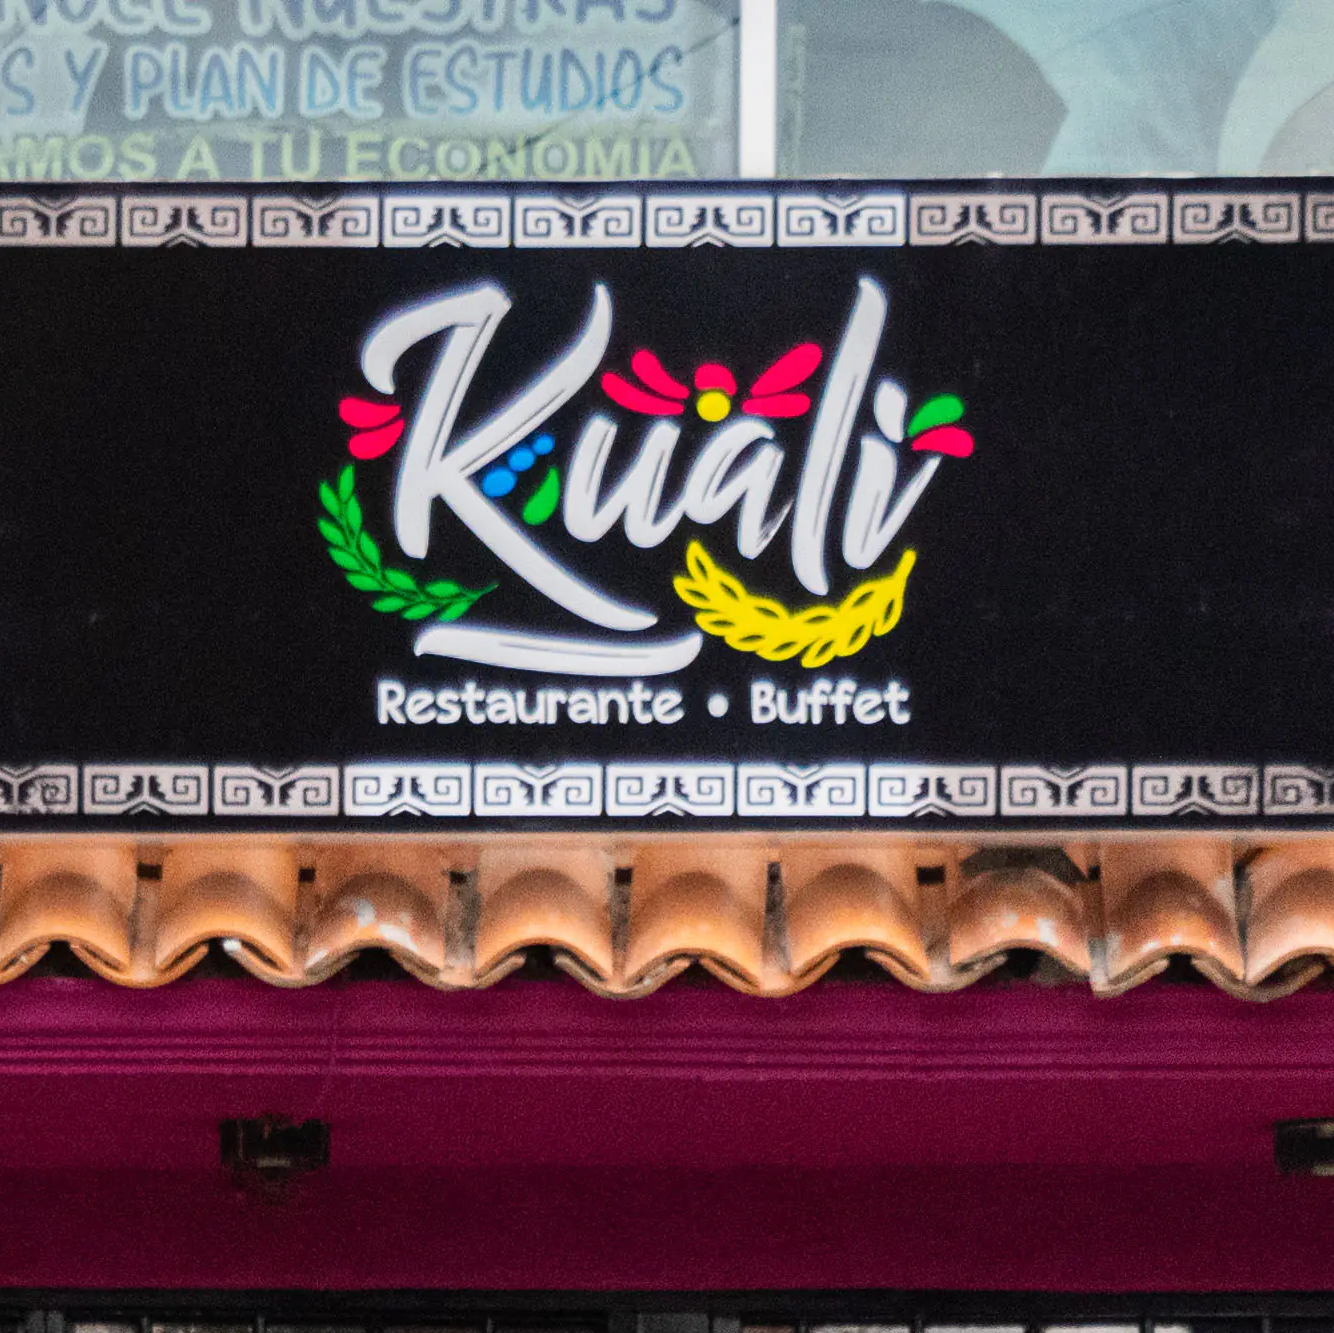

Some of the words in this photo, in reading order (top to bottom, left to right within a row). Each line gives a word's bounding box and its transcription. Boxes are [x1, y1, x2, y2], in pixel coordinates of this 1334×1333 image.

[64, 42, 108, 119] Y
[123, 42, 284, 120] PLAN
[300, 44, 383, 119] DE
[402, 42, 690, 119] ESTUDIOS
[177, 134, 220, 181] A
[250, 130, 322, 181] TU
[359, 276, 943, 632] Kuali
[377, 680, 685, 726] Restaurante
[750, 680, 911, 726] Buffet
